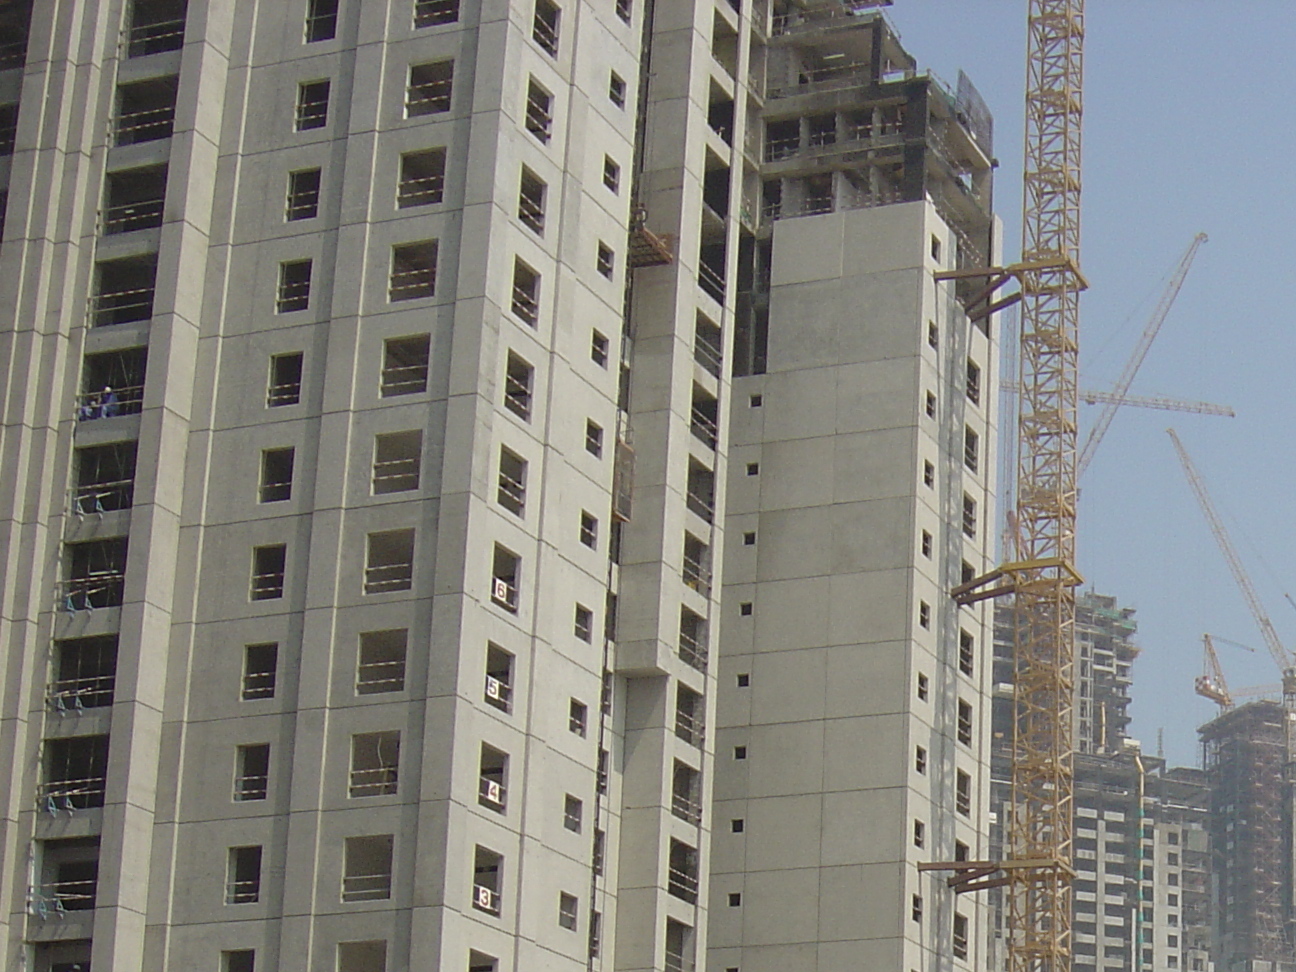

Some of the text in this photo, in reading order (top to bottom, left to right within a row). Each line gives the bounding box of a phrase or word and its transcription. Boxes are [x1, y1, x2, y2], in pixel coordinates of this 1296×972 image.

[497, 583, 505, 598] 6
[489, 681, 497, 695] 5
[490, 785, 497, 800] 4
[481, 890, 488, 906] 3
